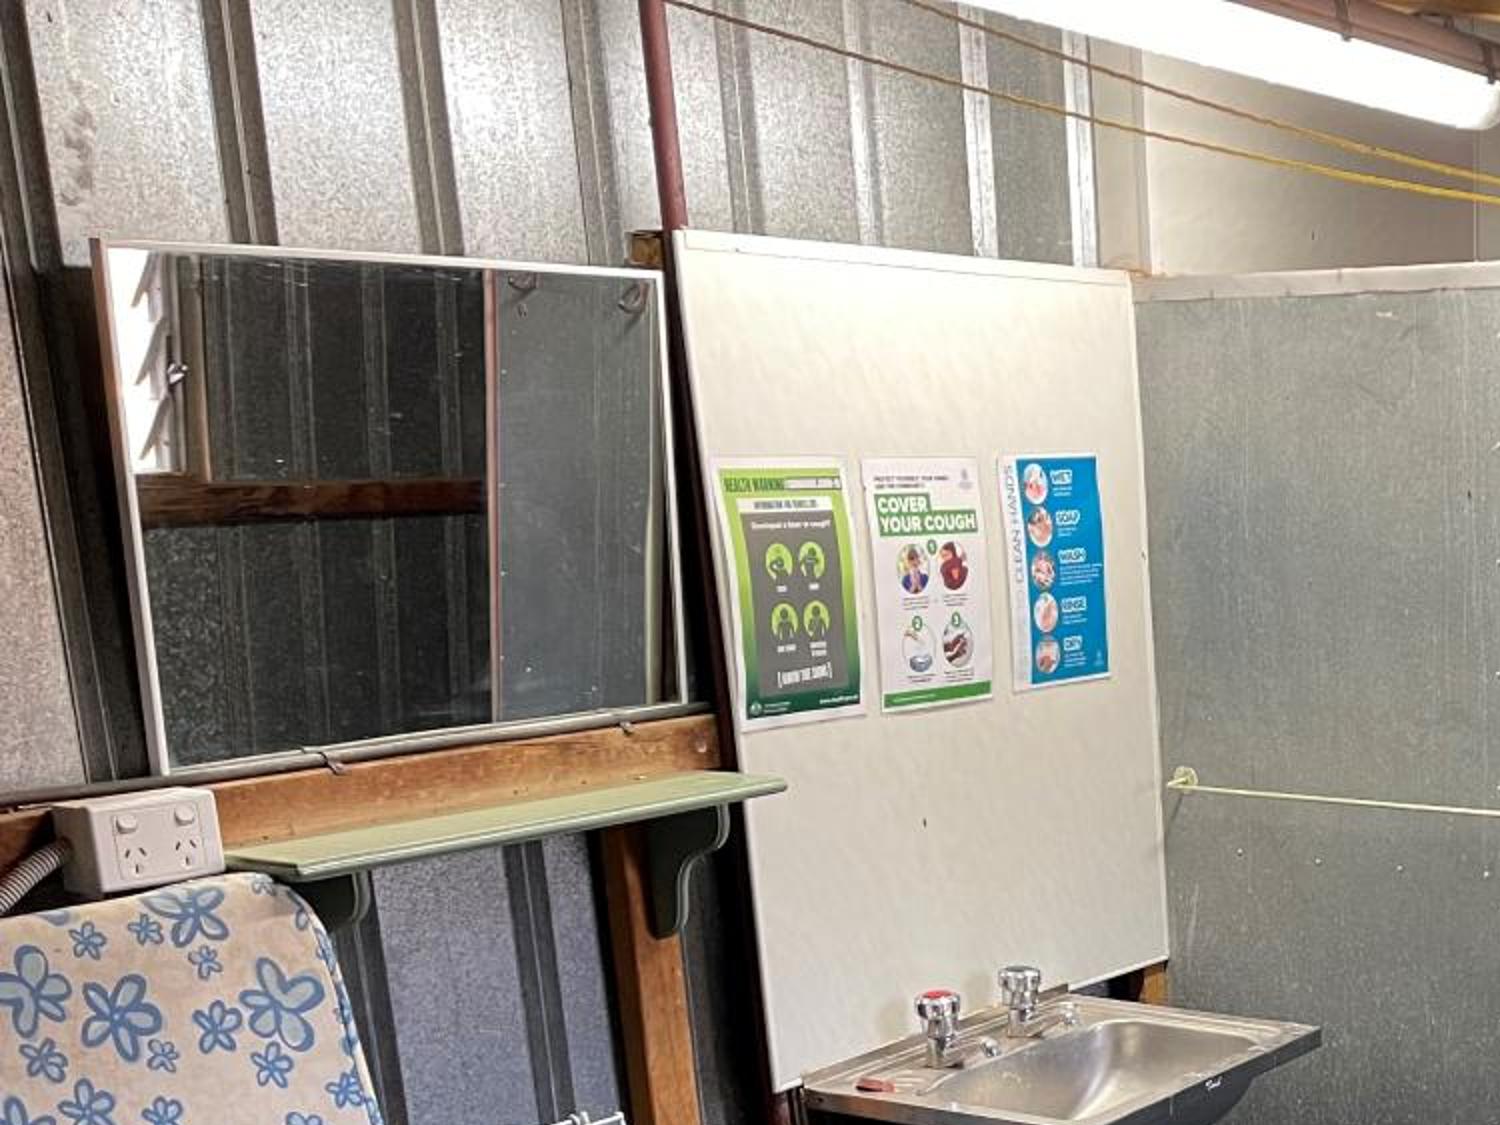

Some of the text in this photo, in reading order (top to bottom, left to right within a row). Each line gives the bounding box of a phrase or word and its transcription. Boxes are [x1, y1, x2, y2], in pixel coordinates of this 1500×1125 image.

[1051, 470, 1072, 484] WET
[1003, 464, 1019, 524] HANDS
[877, 496, 928, 513] COVER
[880, 512, 977, 532] YOUR COUGH
[1056, 509, 1080, 525] SOAP
[1011, 529, 1024, 584] CLEAN
[1058, 548, 1086, 563] WASH
[1061, 597, 1087, 612] RINSE
[1064, 636, 1082, 651] DRY
